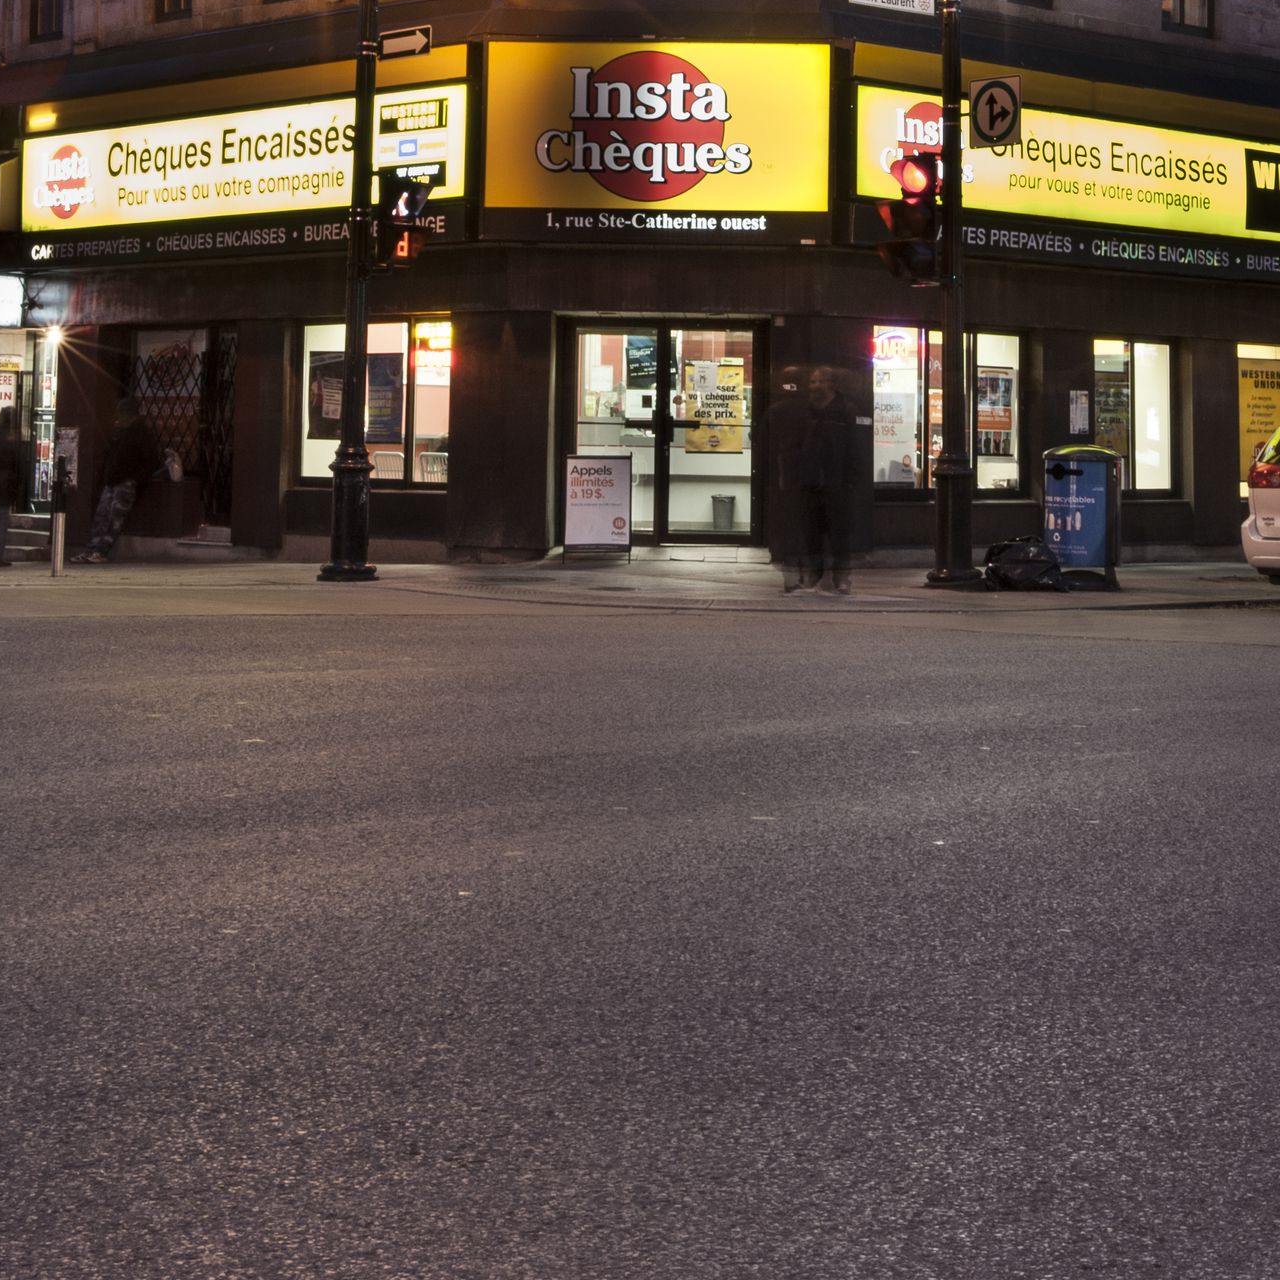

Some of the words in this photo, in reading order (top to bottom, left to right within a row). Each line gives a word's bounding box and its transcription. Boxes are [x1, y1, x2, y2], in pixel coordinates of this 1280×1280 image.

[570, 66, 732, 122] Insta
[381, 101, 437, 120] WESTERN
[397, 114, 437, 132] UNION
[108, 137, 212, 180] Chèques
[221, 115, 356, 166] Encaissés
[535, 128, 752, 184] Chèques
[43, 150, 92, 182] Insta
[1110, 141, 1228, 186] Encaissés
[32, 182, 96, 212] Chèques
[118, 187, 148, 207] Pour
[153, 185, 187, 204] vous
[191, 183, 209, 200] ou
[214, 176, 252, 198] votre
[257, 168, 345, 197] compagnie
[1009, 171, 1042, 191] pour
[1047, 177, 1080, 195] vous
[1084, 181, 1097, 197] et
[1101, 184, 1133, 201] votre
[1137, 189, 1211, 212] compagnie
[546, 212, 560, 230] 1,
[565, 215, 594, 229] rue
[598, 212, 716, 231] Ste-Catherine
[720, 214, 766, 231] ouest
[31, 240, 74, 261] CARTES
[304, 222, 351, 242] BUREA
[694, 408, 711, 418] des
[701, 401, 730, 409] ecevez
[715, 409, 737, 420] prix.
[570, 464, 613, 478] Appels
[570, 476, 615, 488] illimités
[570, 488, 578, 499] à
